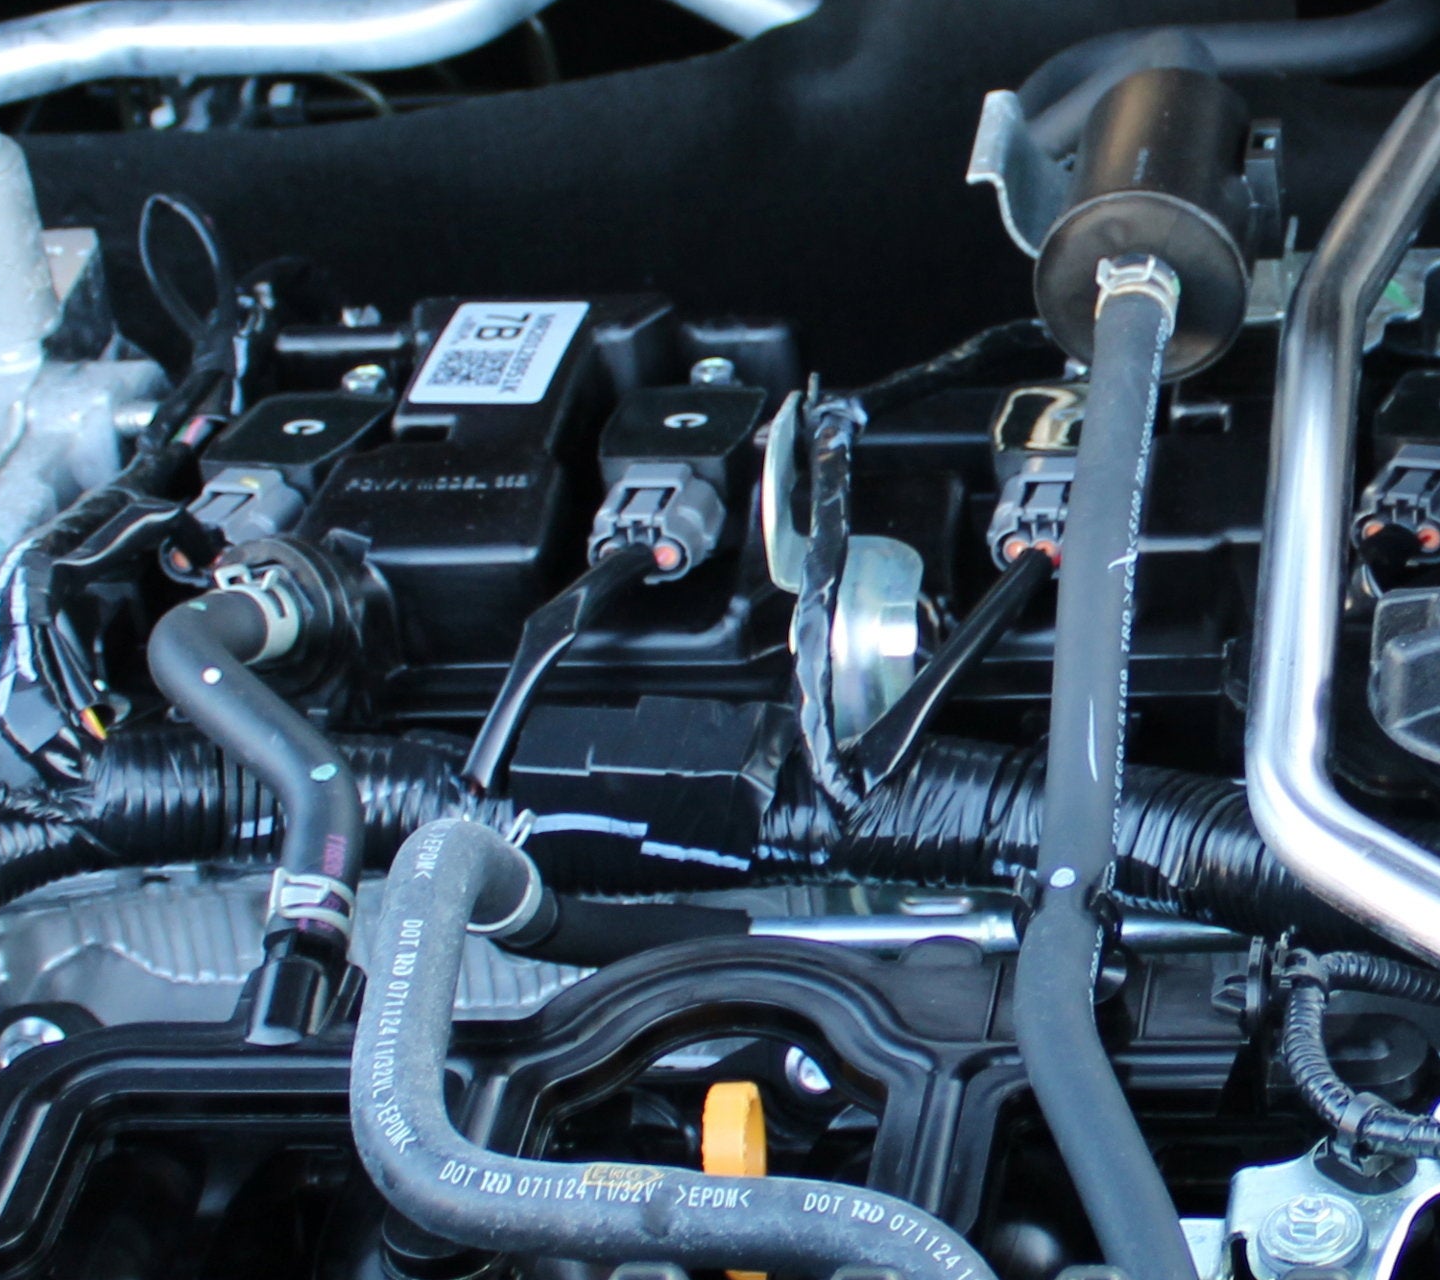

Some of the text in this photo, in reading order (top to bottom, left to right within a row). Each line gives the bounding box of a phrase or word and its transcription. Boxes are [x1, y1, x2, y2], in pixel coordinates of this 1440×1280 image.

[397, 915, 424, 947] DOT
[437, 1158, 477, 1188] DOT
[516, 1174, 586, 1200] 071124
[674, 1184, 752, 1209] >EPDM<
[802, 1191, 844, 1215] DOT
[885, 1209, 964, 1272] 071124
